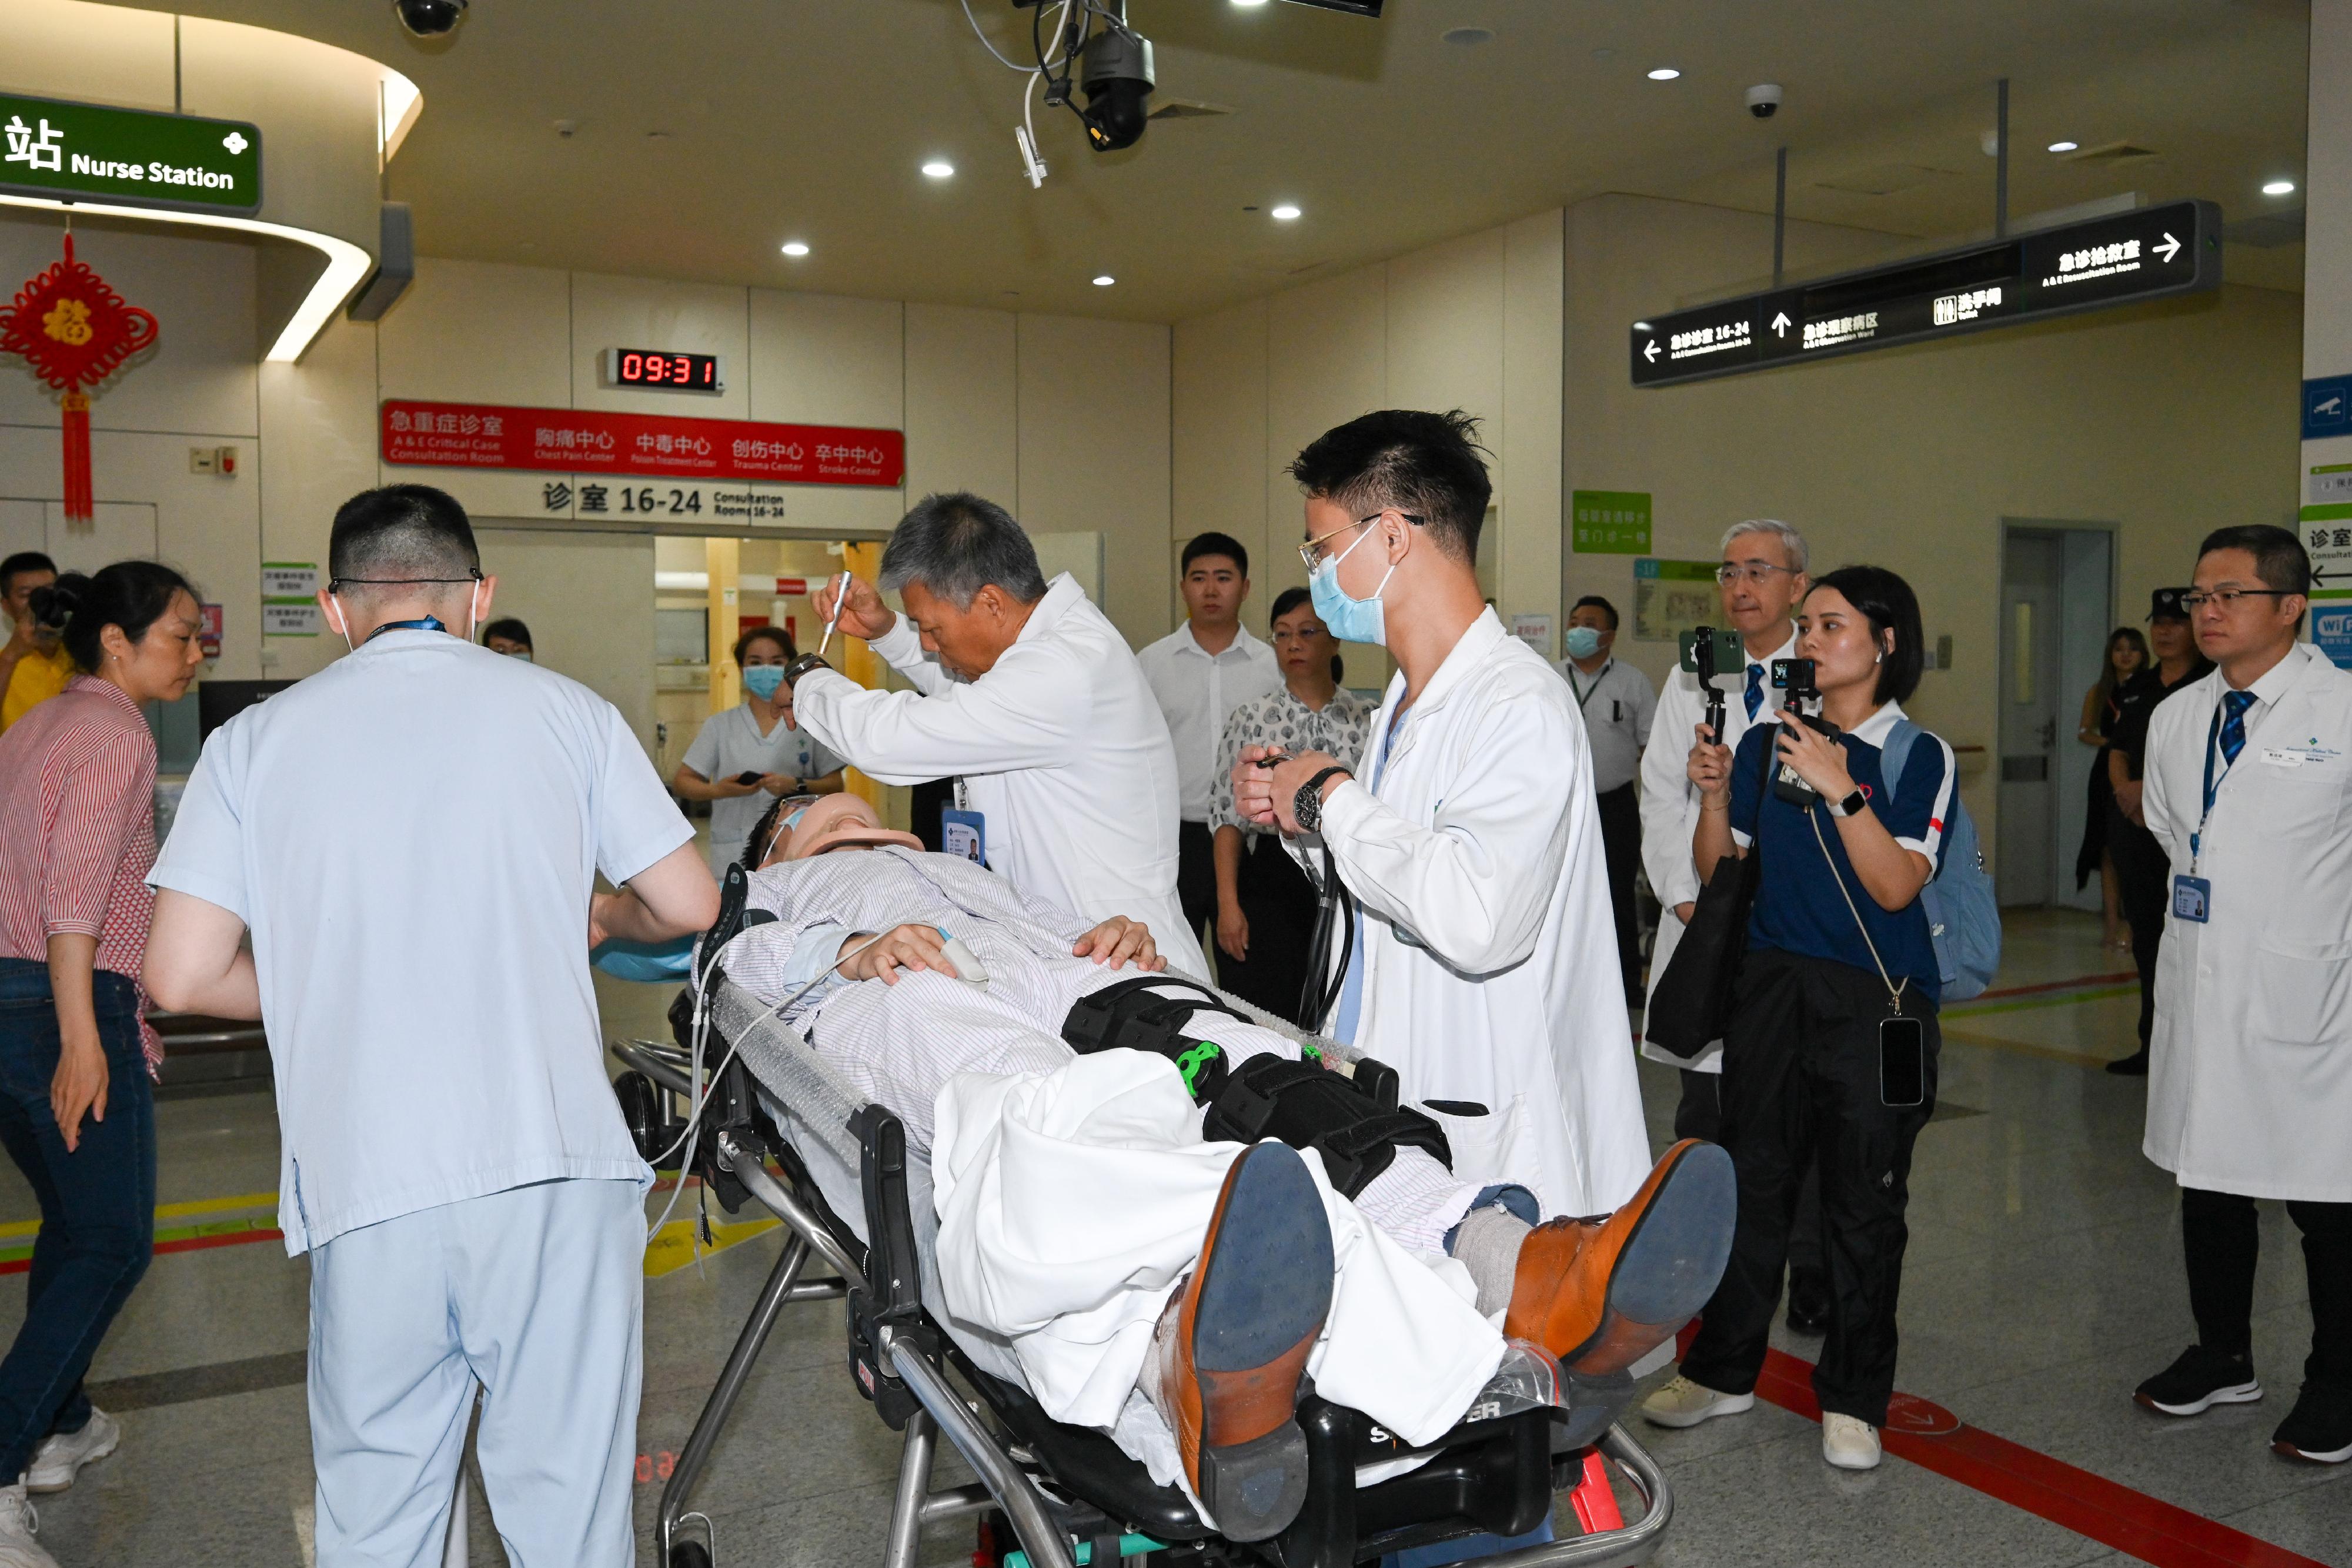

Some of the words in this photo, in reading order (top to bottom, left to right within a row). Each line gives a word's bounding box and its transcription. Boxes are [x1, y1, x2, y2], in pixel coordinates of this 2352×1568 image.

[5, 116, 64, 172] 站
[71, 154, 144, 180] Nurse
[148, 162, 233, 189] Station
[2116, 262, 2140, 273] Room
[1716, 320, 1749, 340] 16-24
[623, 353, 713, 383] 09:31
[390, 410, 504, 436] 急重症诊室
[394, 436, 403, 446] A
[406, 436, 415, 447] &
[417, 436, 425, 447] E
[427, 437, 470, 449] Critical
[472, 439, 501, 450] Case
[535, 427, 615, 450] 胸痛中心
[636, 432, 711, 455] 中毒中心
[390, 448, 467, 461] Consultation
[470, 452, 505, 463] Room
[534, 450, 560, 459] Chest
[563, 450, 583, 460] Pain
[732, 439, 804, 460] 创伤中心
[815, 443, 884, 464] 卒中中心
[733, 459, 769, 470] Trauma
[771, 461, 804, 472] Center
[818, 464, 848, 475] Stroke
[850, 466, 881, 476] Center
[621, 487, 702, 515] 16-24
[713, 492, 783, 505] Consultation
[714, 504, 751, 517] Rooms
[753, 506, 784, 518] 16-24
